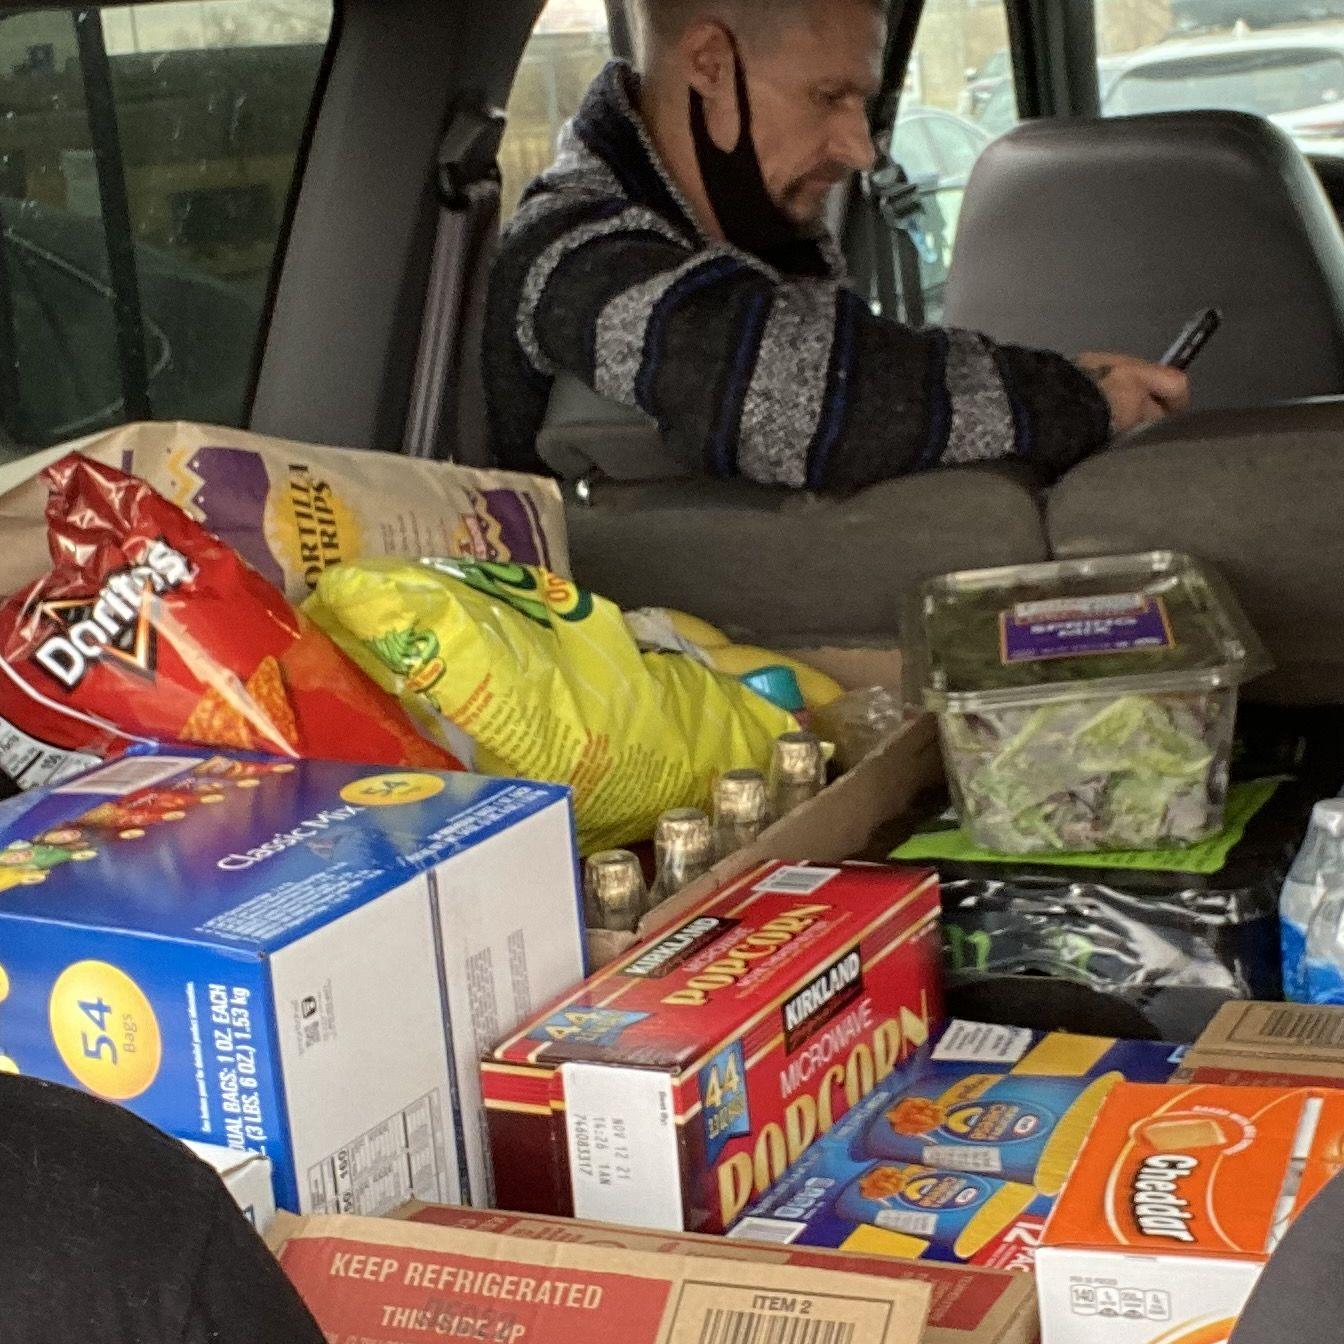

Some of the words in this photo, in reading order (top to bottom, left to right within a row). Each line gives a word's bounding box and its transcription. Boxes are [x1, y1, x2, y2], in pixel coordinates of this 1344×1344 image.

[288, 463, 322, 593] ORTILLA
[312, 478, 342, 567] TRIPS
[36, 539, 190, 689] Doritos
[217, 824, 317, 870] Classic
[304, 804, 367, 833] Mix
[624, 917, 721, 975] KIRKLAND
[660, 903, 836, 1006] POPCORN
[208, 983, 230, 1025] EACH
[230, 987, 251, 1005] kg
[785, 951, 861, 1032] KIRKLAND
[77, 995, 118, 1066] 54
[121, 1012, 139, 1054] Bags
[214, 1028, 234, 1051] OZ.
[231, 1007, 252, 1039] 1.53
[779, 997, 873, 1099] MICROWAVE
[216, 1055, 235, 1063] 1
[705, 1051, 740, 1109] 44
[219, 1067, 242, 1113] BAGS:
[241, 1092, 263, 1123] LBS.
[718, 988, 929, 1229] POPCORN
[612, 1118, 626, 1140] NOV
[614, 1146, 629, 1159] 12
[616, 1166, 631, 1180] 21
[1134, 1155, 1199, 1243] Cheddar
[329, 1252, 400, 1283] KEEP
[403, 1261, 604, 1310] REFRIGERATED
[753, 1294, 796, 1313] ITEM
[799, 1299, 813, 1314] 2
[381, 1305, 432, 1332] THIS
[435, 1311, 489, 1339] SIDE
